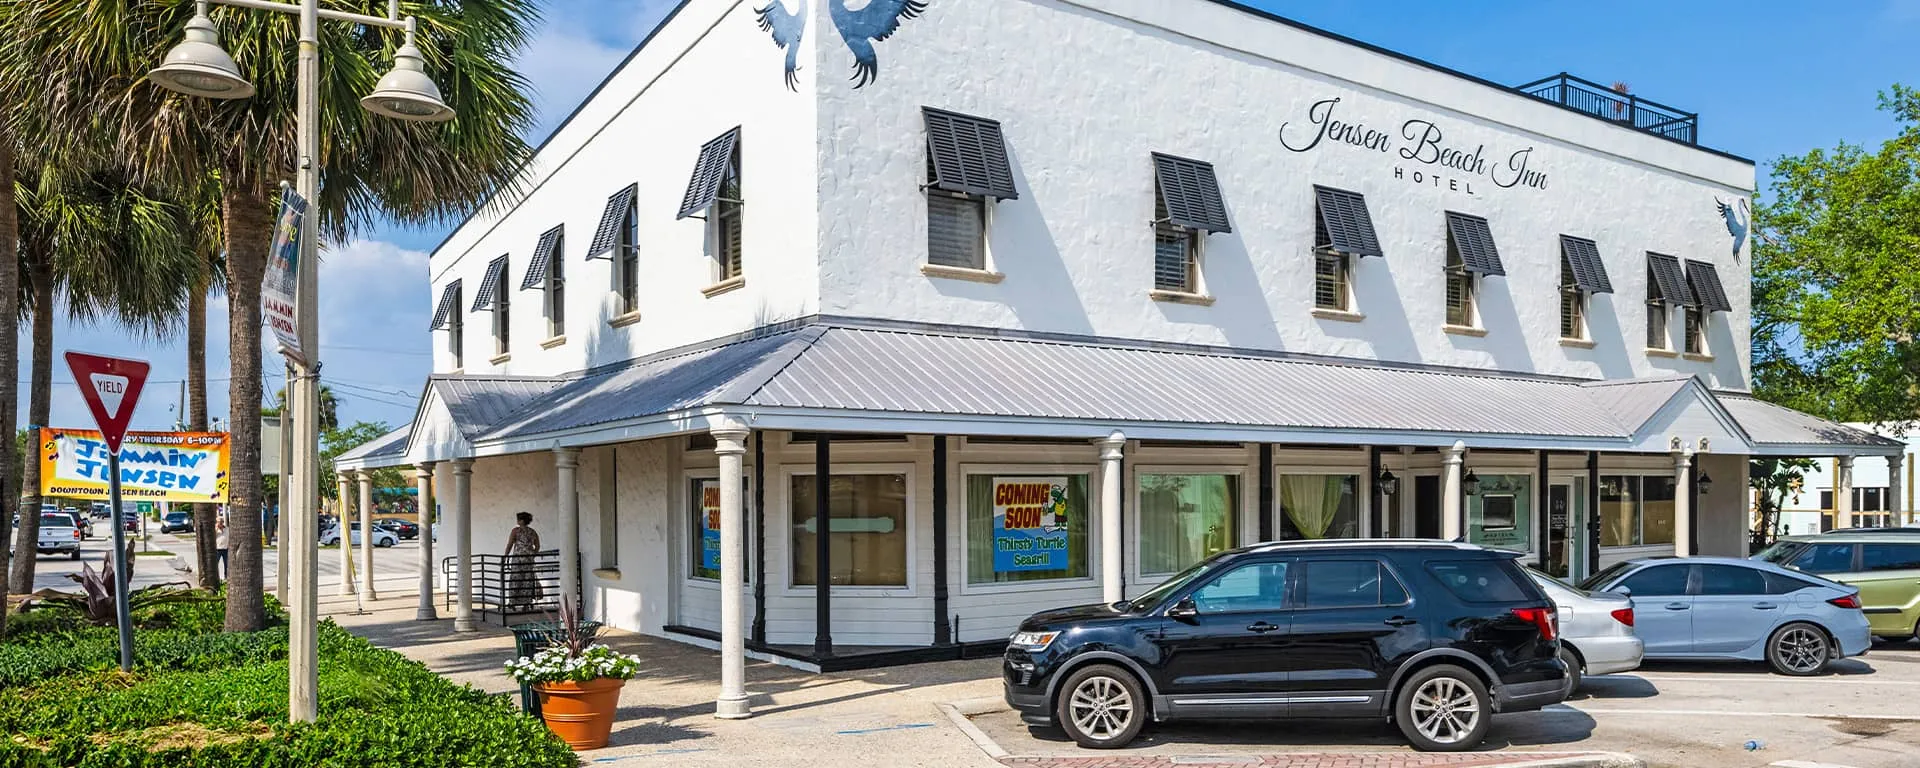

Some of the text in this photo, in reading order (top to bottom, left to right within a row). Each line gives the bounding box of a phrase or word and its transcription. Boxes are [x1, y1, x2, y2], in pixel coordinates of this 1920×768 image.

[1279, 97, 1548, 190] Jensen Beach Inn
[1394, 166, 1475, 194] HOTEL
[97, 380, 123, 394] YIELD
[139, 435, 185, 444] THURSDAY
[50, 486, 167, 497] DOWNTOWN JSEN BEACH
[996, 483, 1050, 506] COMING
[1005, 507, 1042, 529] SOON
[997, 535, 1066, 552] Thirsty Turtle
[1014, 552, 1050, 566] Seagrill
